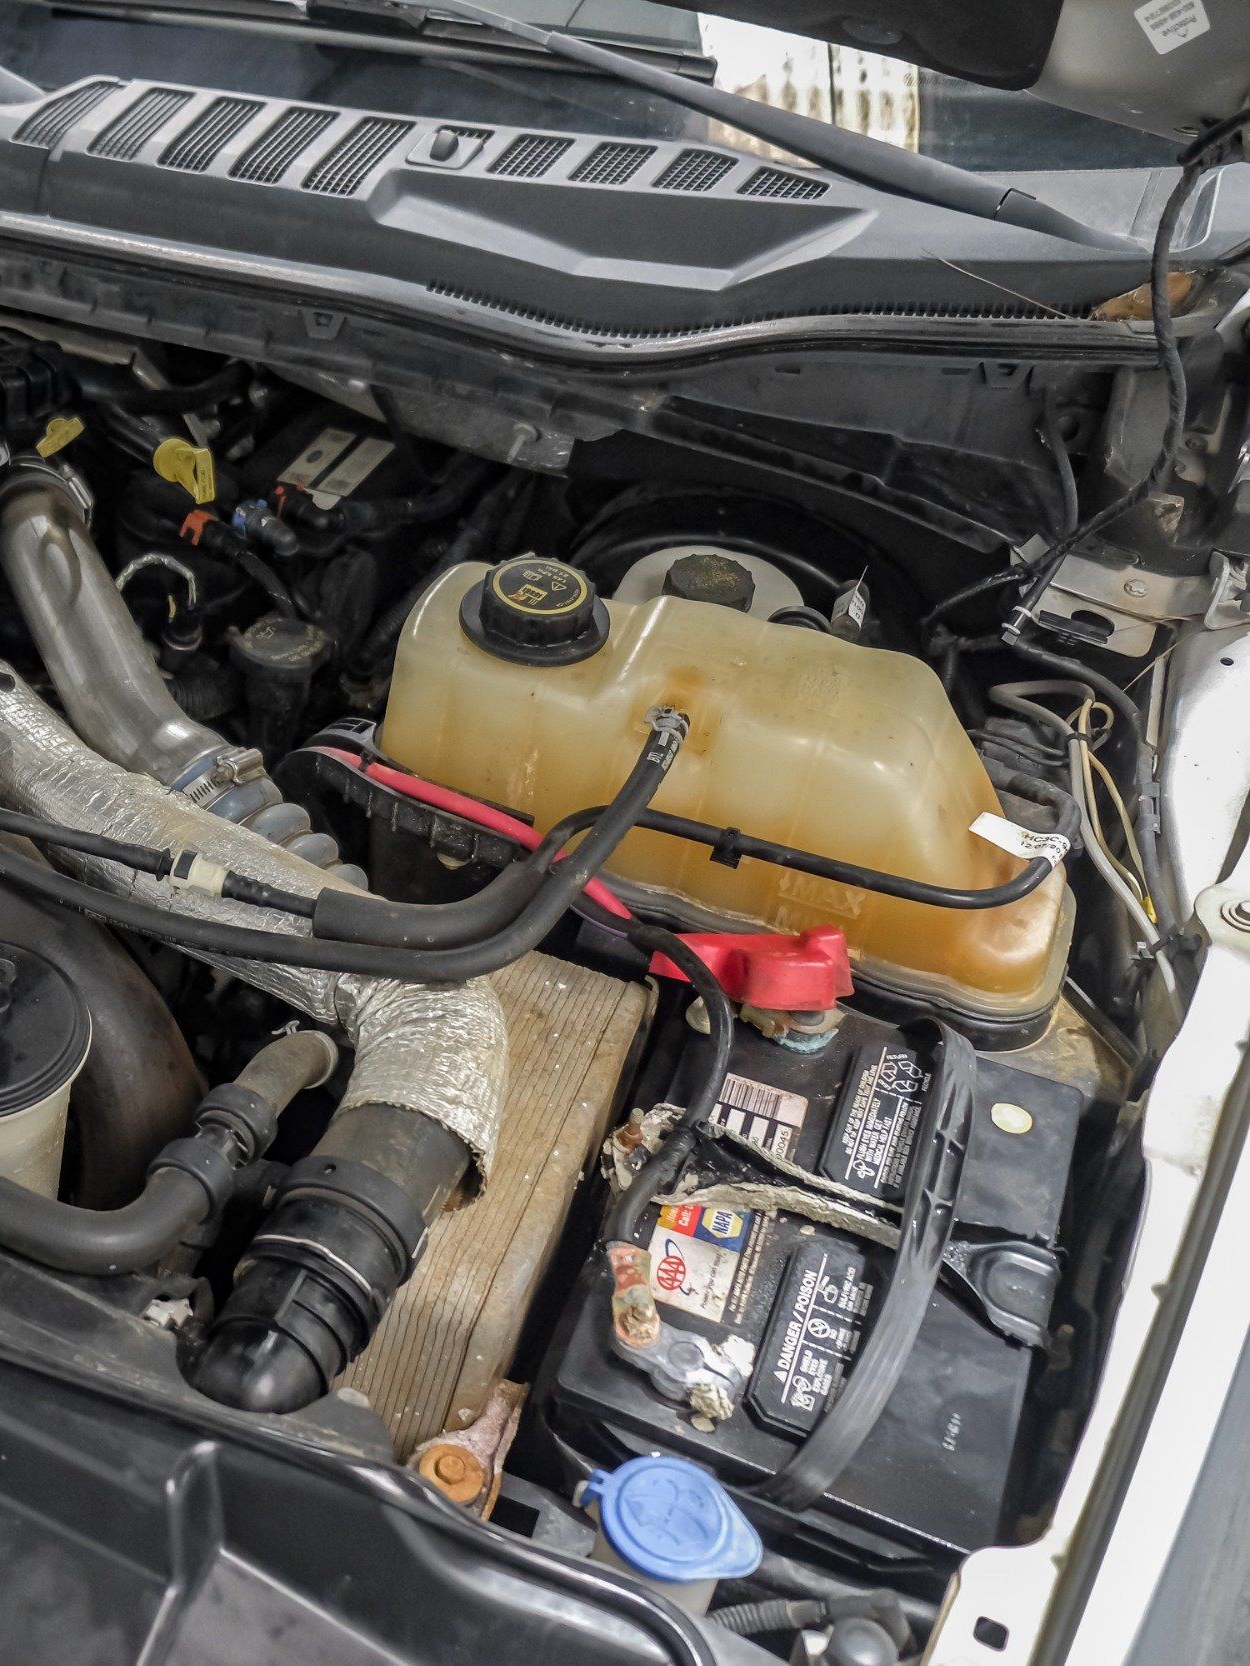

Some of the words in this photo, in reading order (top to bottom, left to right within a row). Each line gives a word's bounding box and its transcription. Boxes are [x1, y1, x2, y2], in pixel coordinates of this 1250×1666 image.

[711, 1209, 733, 1234] NAPA
[658, 1257, 685, 1289] AAA
[776, 1320, 802, 1369] DANGER
[793, 1268, 817, 1312] POISON
